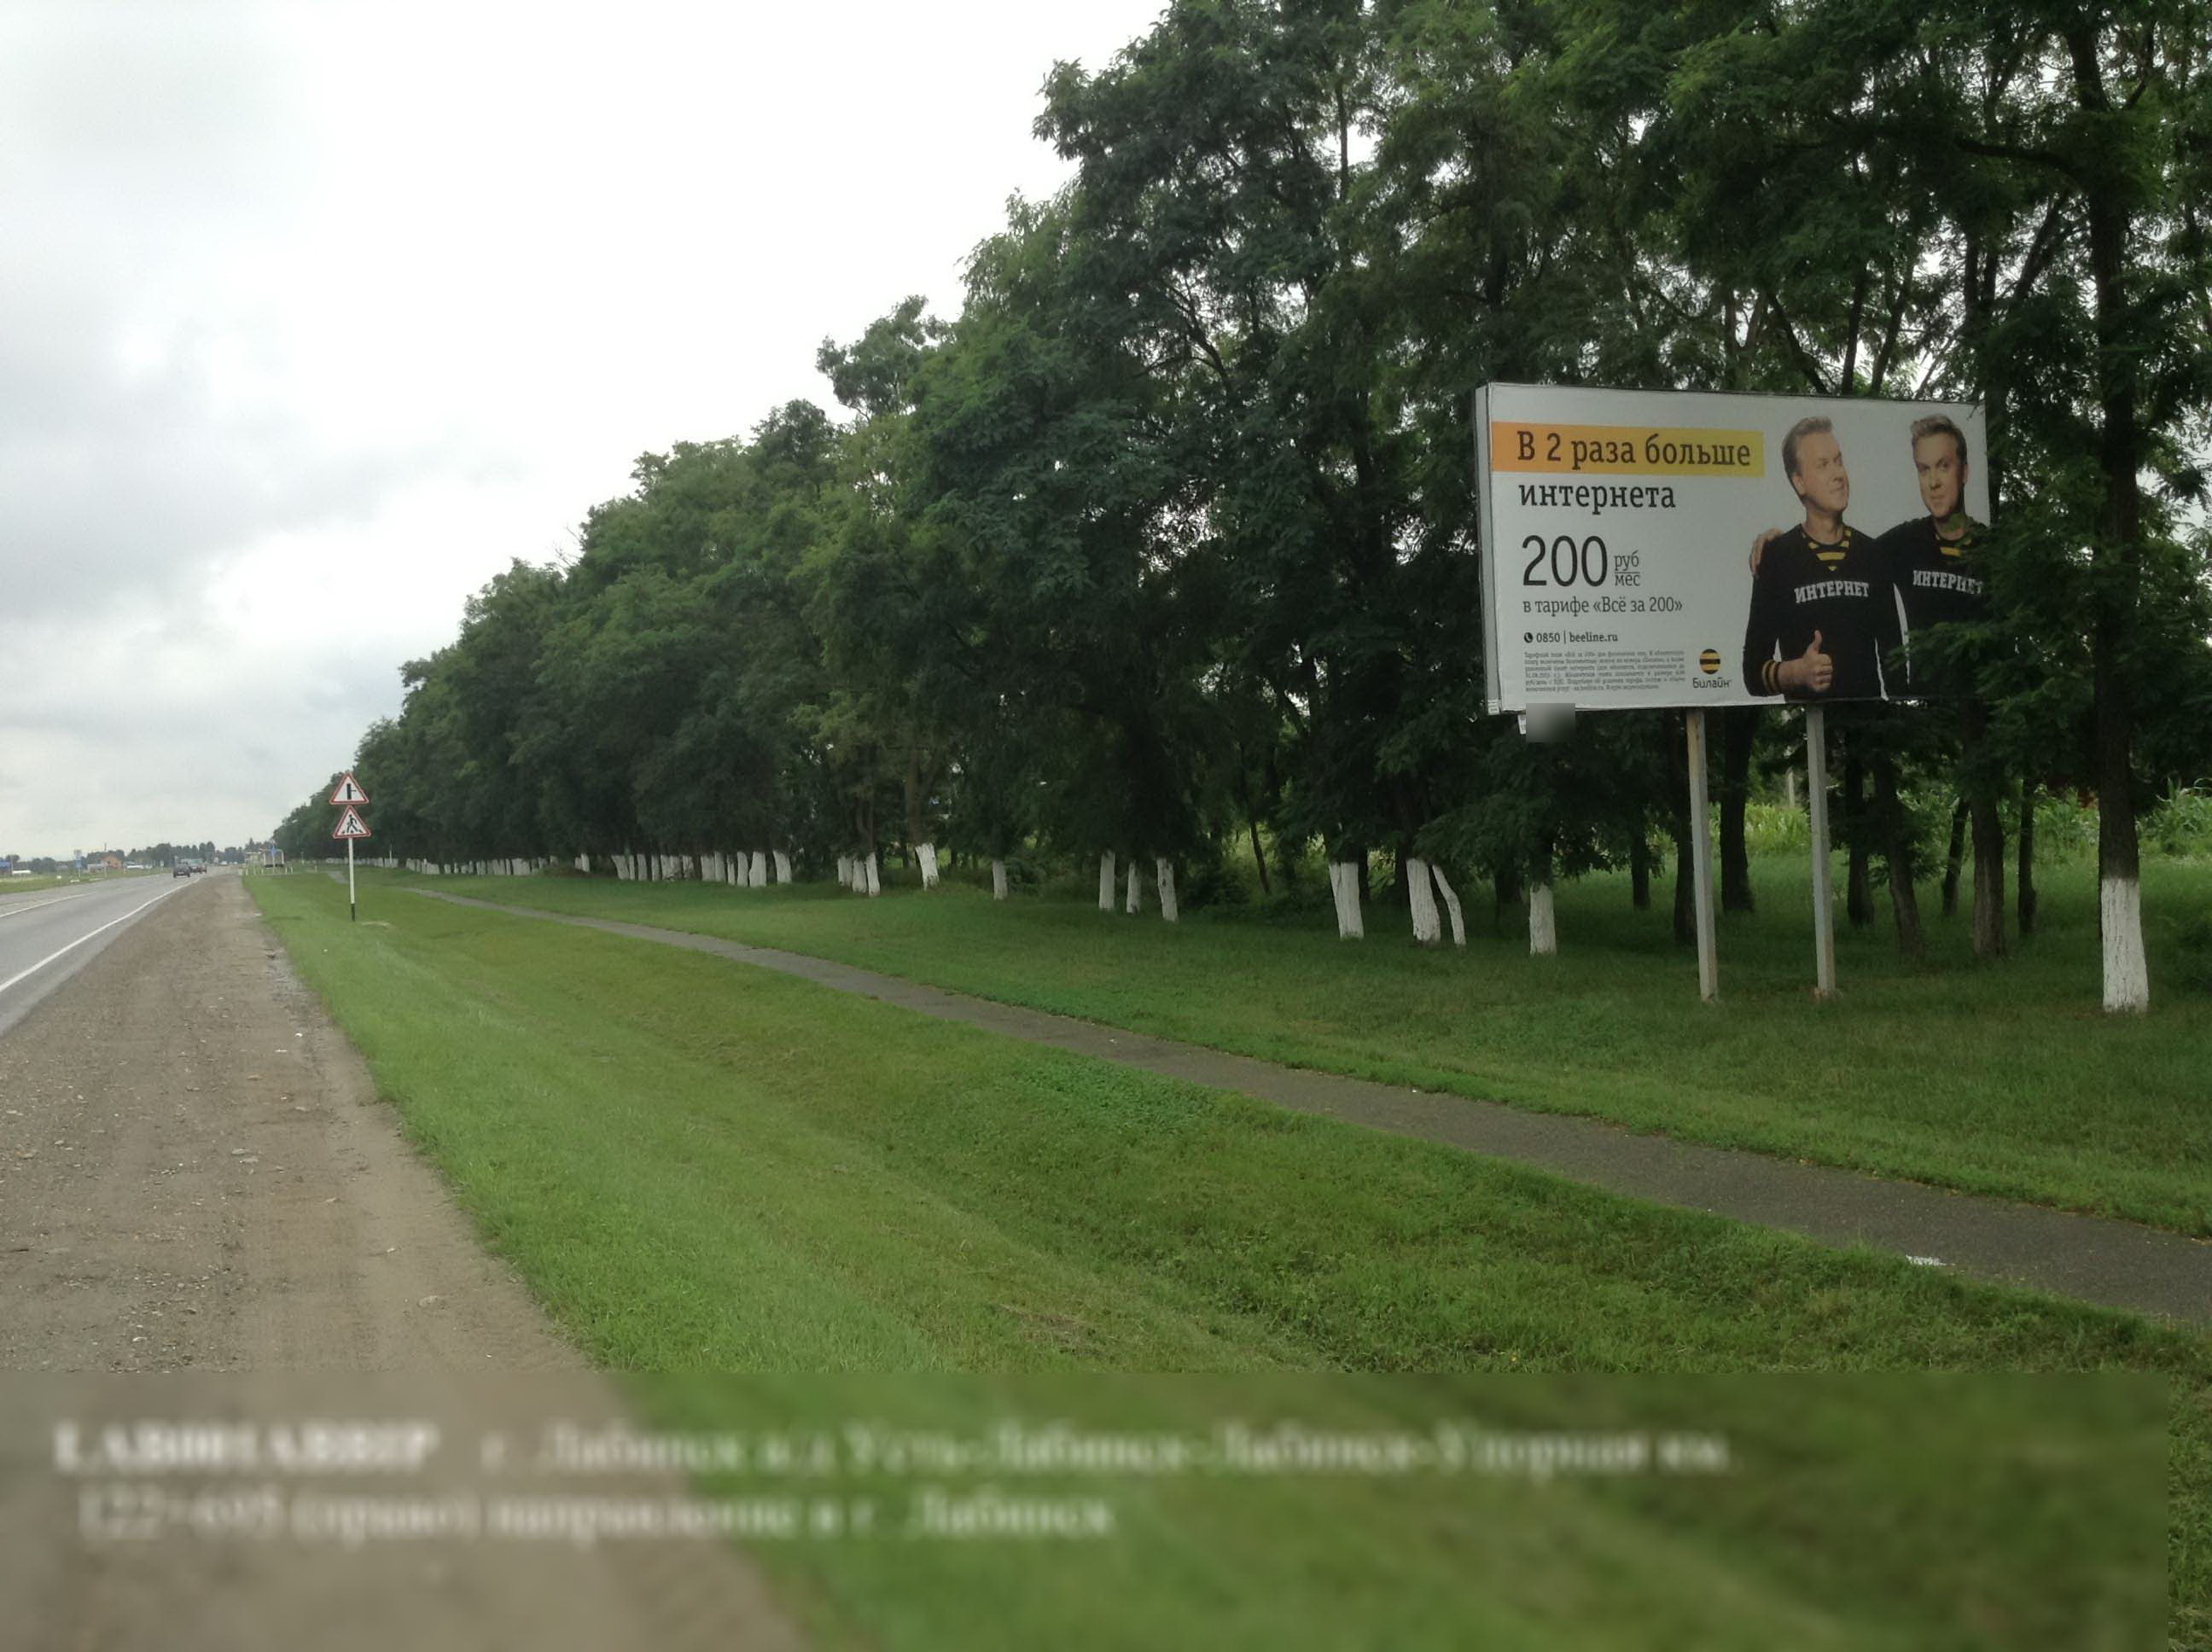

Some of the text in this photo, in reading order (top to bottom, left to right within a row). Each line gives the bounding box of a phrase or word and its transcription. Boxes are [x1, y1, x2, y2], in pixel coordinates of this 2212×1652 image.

[1517, 431, 1750, 470] В 2 раза больше
[1518, 485, 1676, 515] интернета
[1522, 535, 1608, 586] 200
[1614, 550, 1639, 571] руб
[1615, 573, 1640, 586] мес
[1794, 580, 1869, 603] ИНТЕРНЕТ
[1522, 596, 1683, 617] в тарифе «Всё за 200»
[1536, 632, 1618, 643] 0850 beeline.ru
[1693, 677, 1731, 689] Билайн
